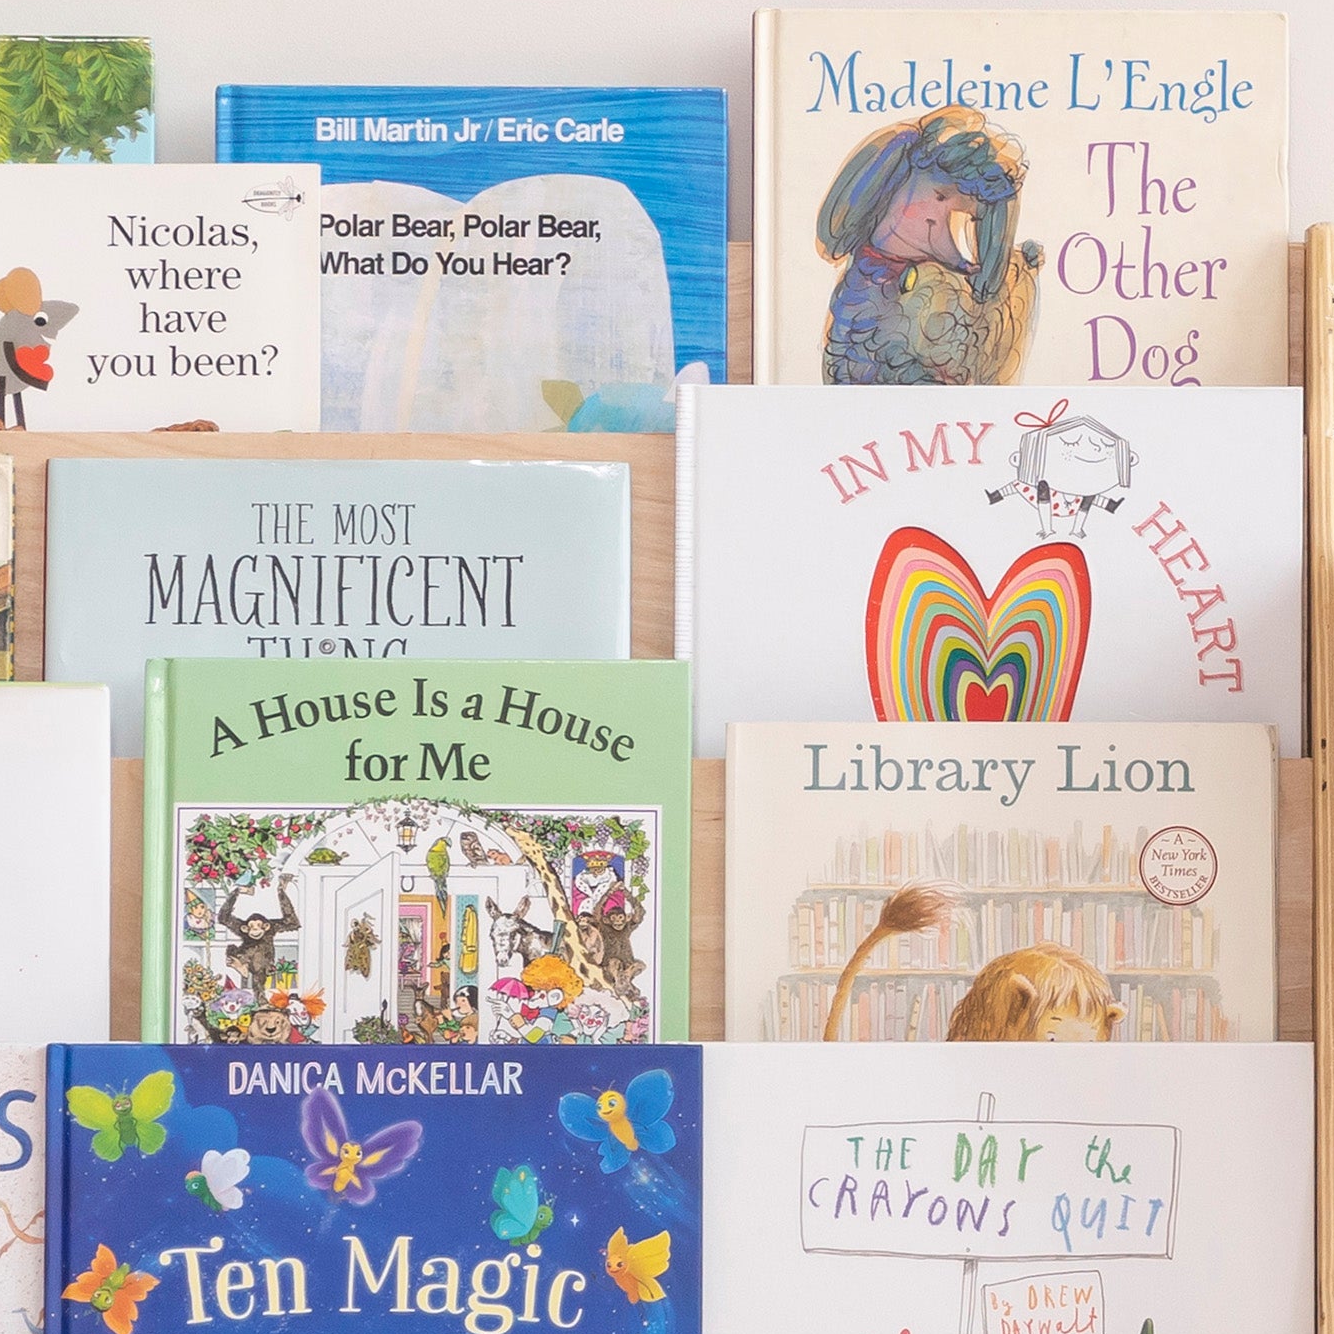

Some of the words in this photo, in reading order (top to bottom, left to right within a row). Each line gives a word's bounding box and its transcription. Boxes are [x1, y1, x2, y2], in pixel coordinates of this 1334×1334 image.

[806, 51, 1049, 113] Madeleine
[1067, 53, 1253, 123] L'Engle
[316, 118, 356, 142] Bill
[364, 118, 447, 142] Martin
[454, 118, 480, 142] Jr
[498, 118, 548, 142] Eric
[555, 118, 624, 143] Carle
[1087, 142, 1198, 217] The
[108, 215, 259, 254] Nicolas,
[320, 214, 384, 238] Polar
[392, 215, 455, 242] Bear,
[464, 214, 530, 238] Polar
[537, 215, 602, 242] Bear,
[126, 260, 241, 289] where
[320, 251, 384, 276] What
[393, 252, 429, 276] Do
[436, 252, 486, 276] You
[493, 252, 571, 276] Hear?
[1057, 225, 1227, 300] Other
[139, 302, 227, 333] have
[87, 349, 156, 383] you
[170, 345, 279, 377] been?
[1084, 314, 1201, 386] Dog
[251, 503, 314, 546] THE
[333, 503, 417, 546] MOST
[821, 440, 889, 505] IN
[900, 421, 993, 472] MY
[1131, 500, 1244, 694] HEART
[143, 553, 524, 629] MAGNIFICENT
[209, 715, 248, 758] A
[250, 688, 398, 740] House
[413, 678, 449, 717] Is
[461, 694, 482, 721] a
[494, 686, 635, 763] House
[344, 739, 408, 782] for
[416, 743, 491, 782] Me
[803, 744, 1035, 807] Library
[1057, 744, 1196, 793] Lion
[1151, 848, 1179, 861] New
[1182, 847, 1208, 861] York
[1161, 864, 1198, 877] Times
[1149, 875, 1209, 899] BESTSELLER
[228, 1062, 344, 1096] DANICA
[847, 1136, 917, 1171] THE
[953, 1133, 1043, 1187] DAY
[1085, 1135, 1132, 1185] the
[808, 1174, 1017, 1237] CRAYONS
[1051, 1193, 1165, 1252] QUIT
[159, 1237, 312, 1326] Ten
[1028, 1284, 1093, 1311] DREW
